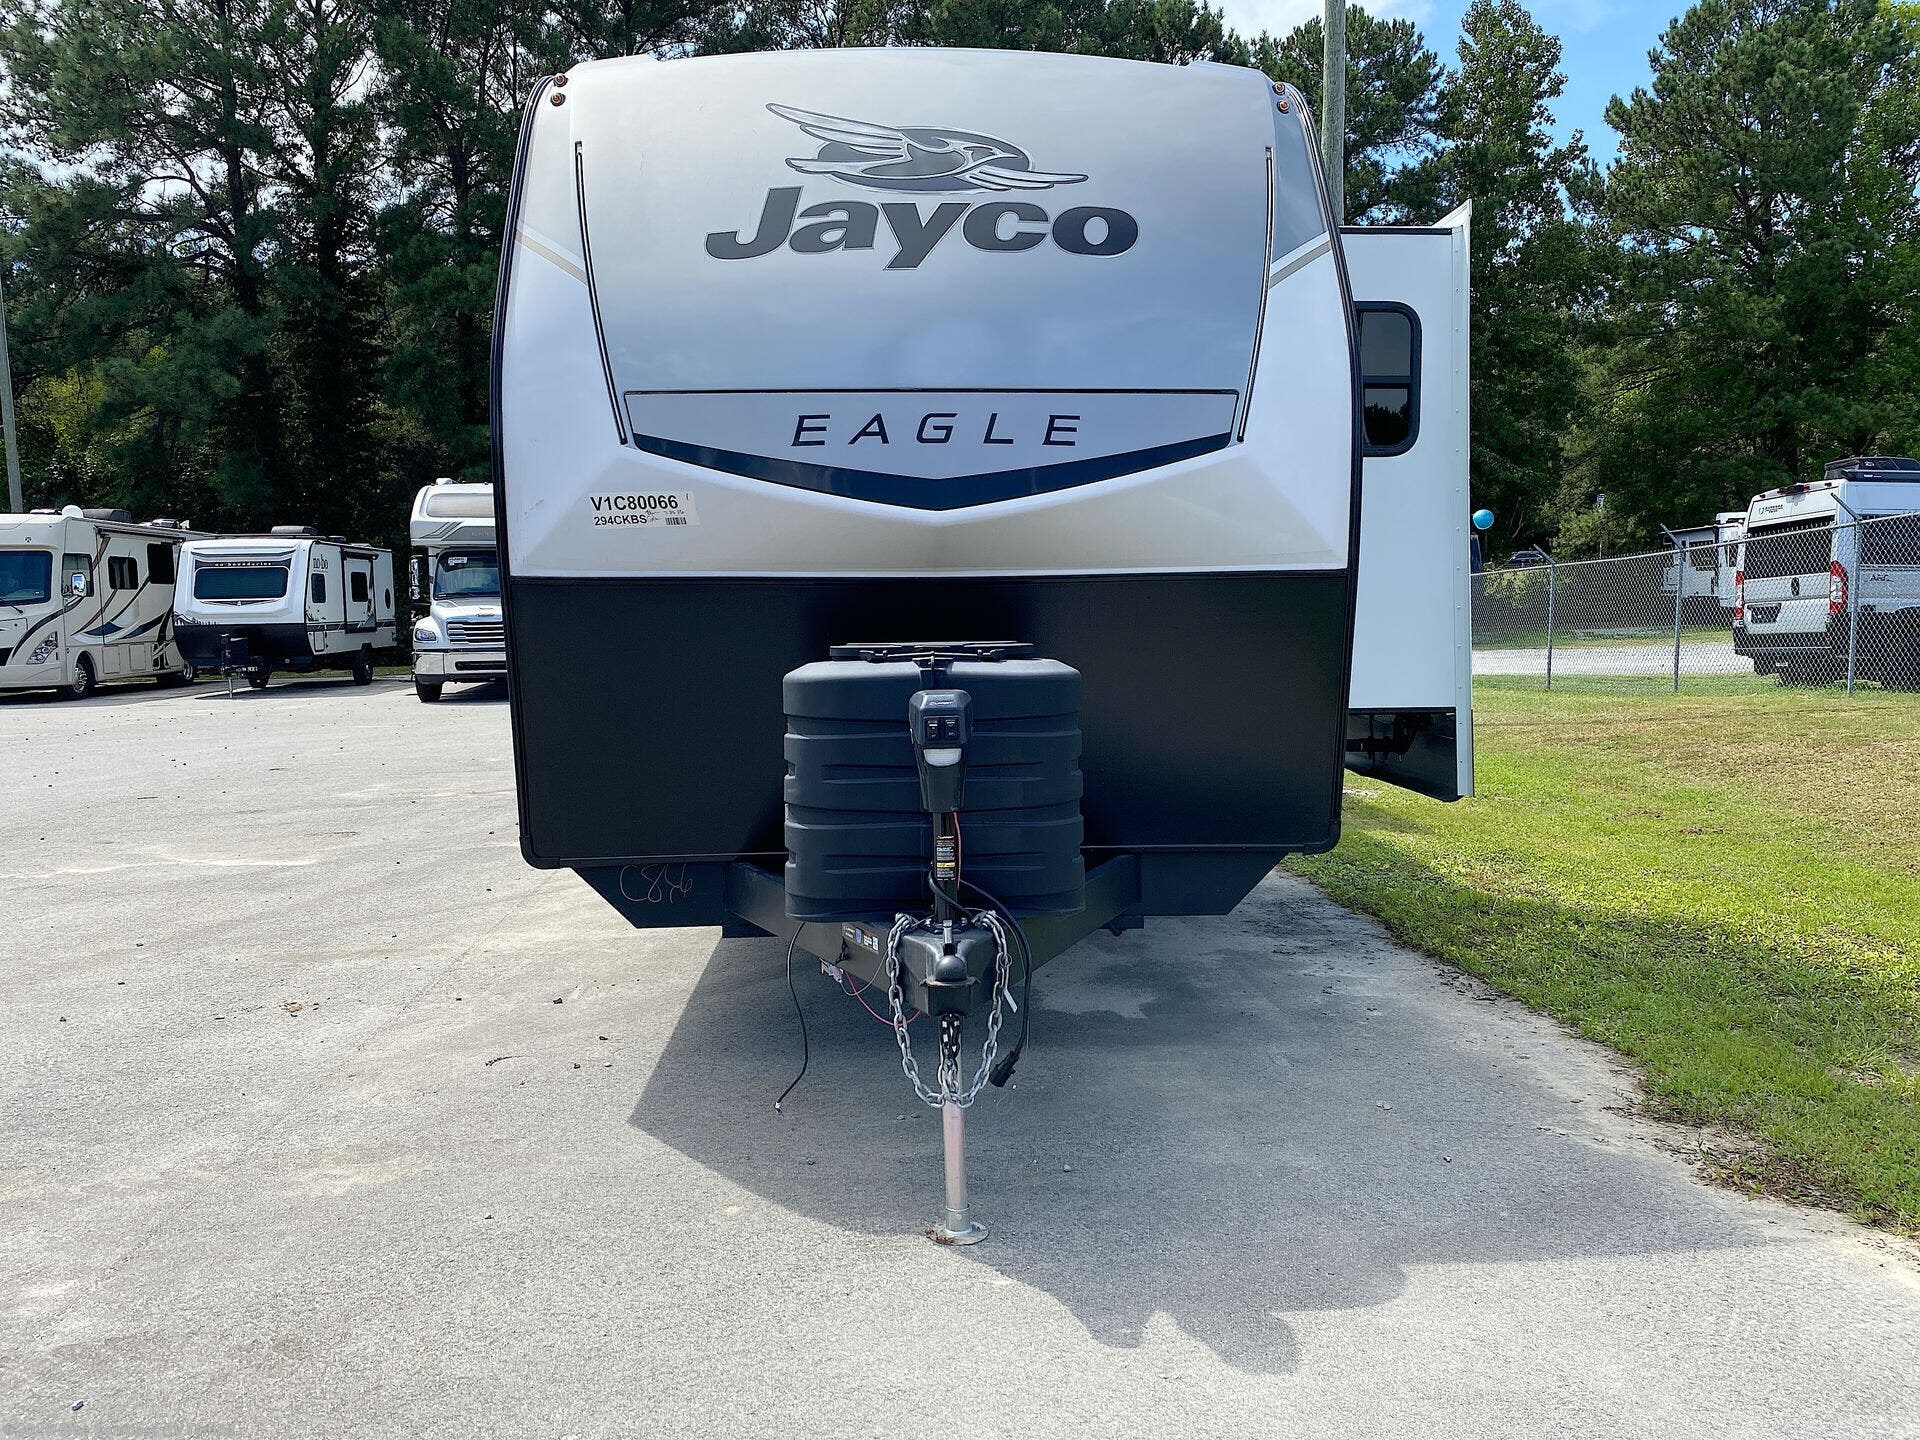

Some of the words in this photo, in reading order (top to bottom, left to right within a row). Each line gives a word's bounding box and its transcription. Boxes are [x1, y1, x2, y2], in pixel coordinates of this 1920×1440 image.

[705, 185, 1140, 271] Jayco
[791, 412, 1081, 447] EAGLE
[590, 494, 679, 512] V1C80066
[593, 514, 648, 526] 294CKBS
